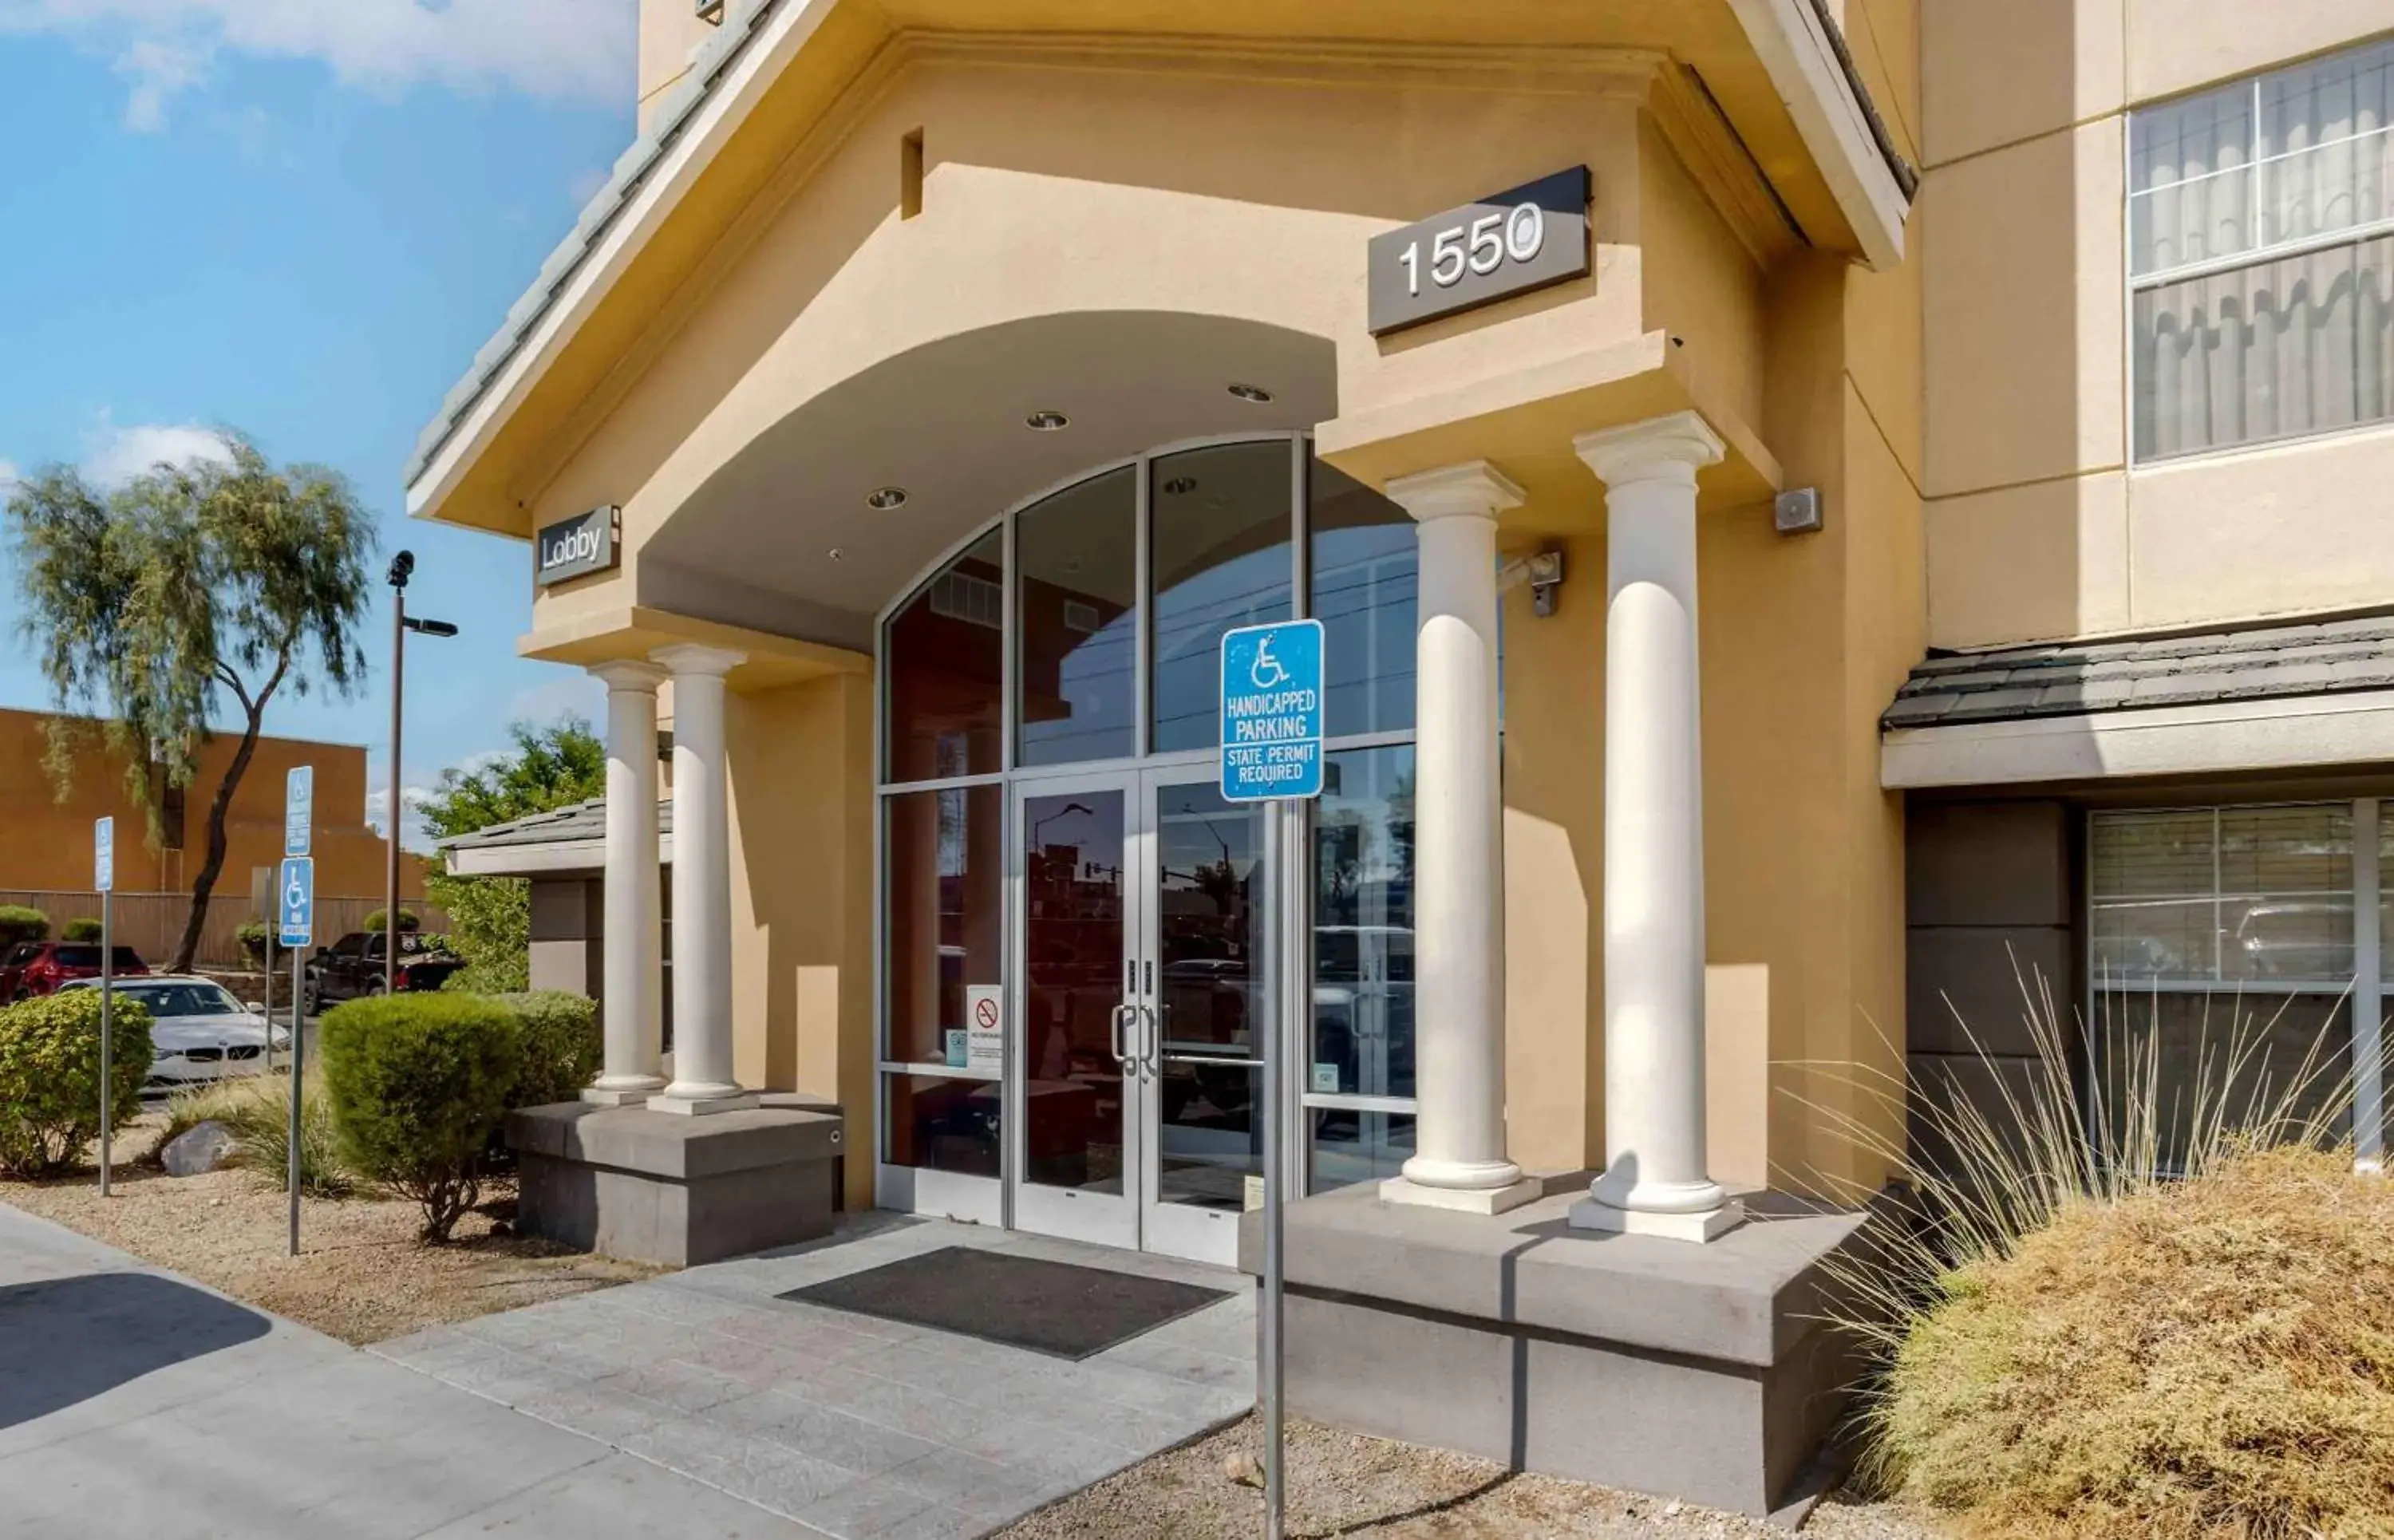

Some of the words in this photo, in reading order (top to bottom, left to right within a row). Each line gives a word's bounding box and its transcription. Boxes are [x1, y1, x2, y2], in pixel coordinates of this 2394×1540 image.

[1399, 202, 1544, 294] 1550
[543, 527, 602, 568] Lobby
[1227, 689, 1316, 718] HANDICAPPED
[1236, 715, 1306, 741] PARKING
[1228, 748, 1262, 767] STATE
[1267, 744, 1316, 764] PERMIT
[1238, 764, 1303, 784] REQUIRED
